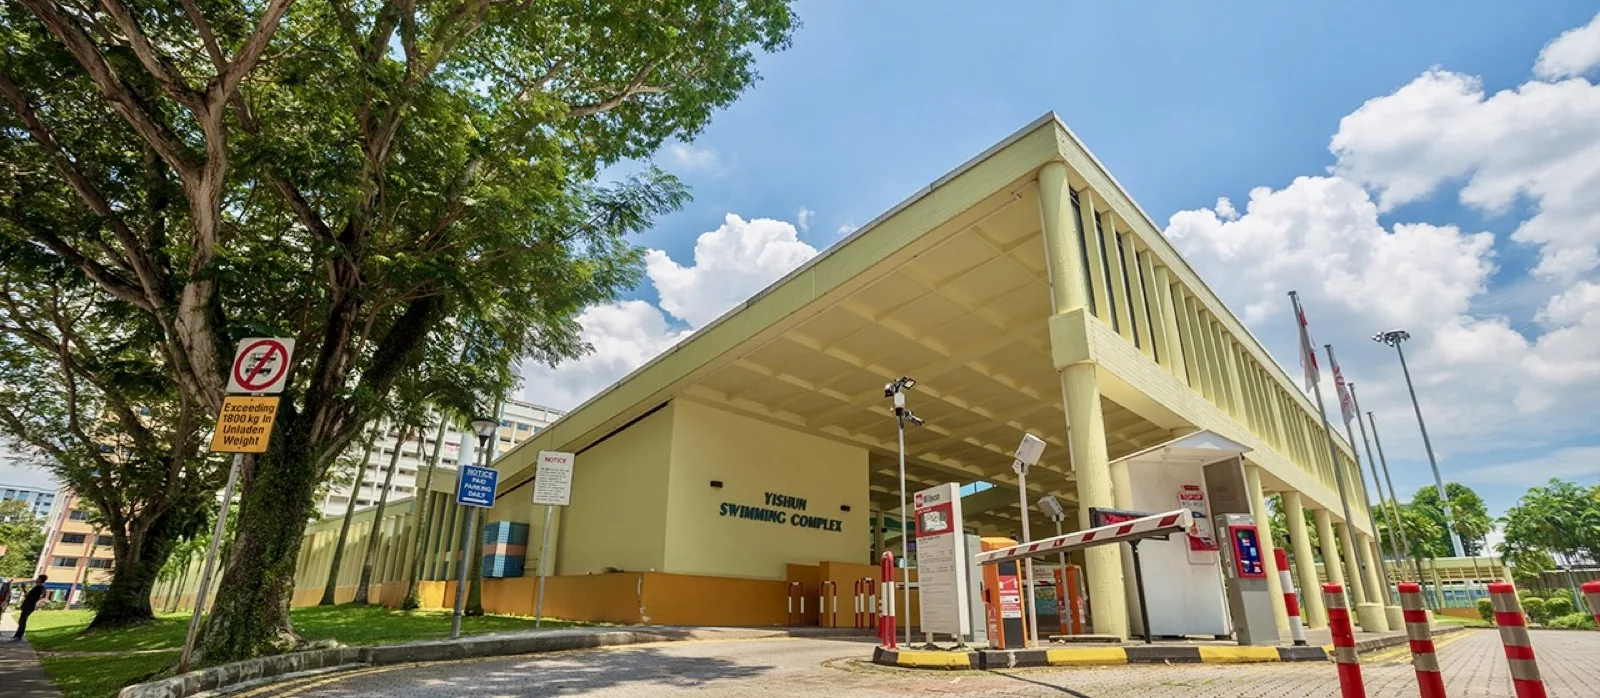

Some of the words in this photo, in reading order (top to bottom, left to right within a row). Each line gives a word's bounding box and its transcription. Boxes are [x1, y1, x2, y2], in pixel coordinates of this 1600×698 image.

[224, 402, 275, 413] Exceeding
[223, 415, 246, 423] 1800
[248, 414, 260, 424] kg
[223, 426, 265, 434] Unladen
[223, 436, 260, 447] Weight
[467, 468, 494, 479] NOTICE
[472, 477, 487, 485] PAID
[464, 483, 492, 492] PARKING
[764, 492, 807, 510] YISHUN
[720, 502, 786, 524] SWIMMING
[790, 513, 842, 532] COMPLEX
